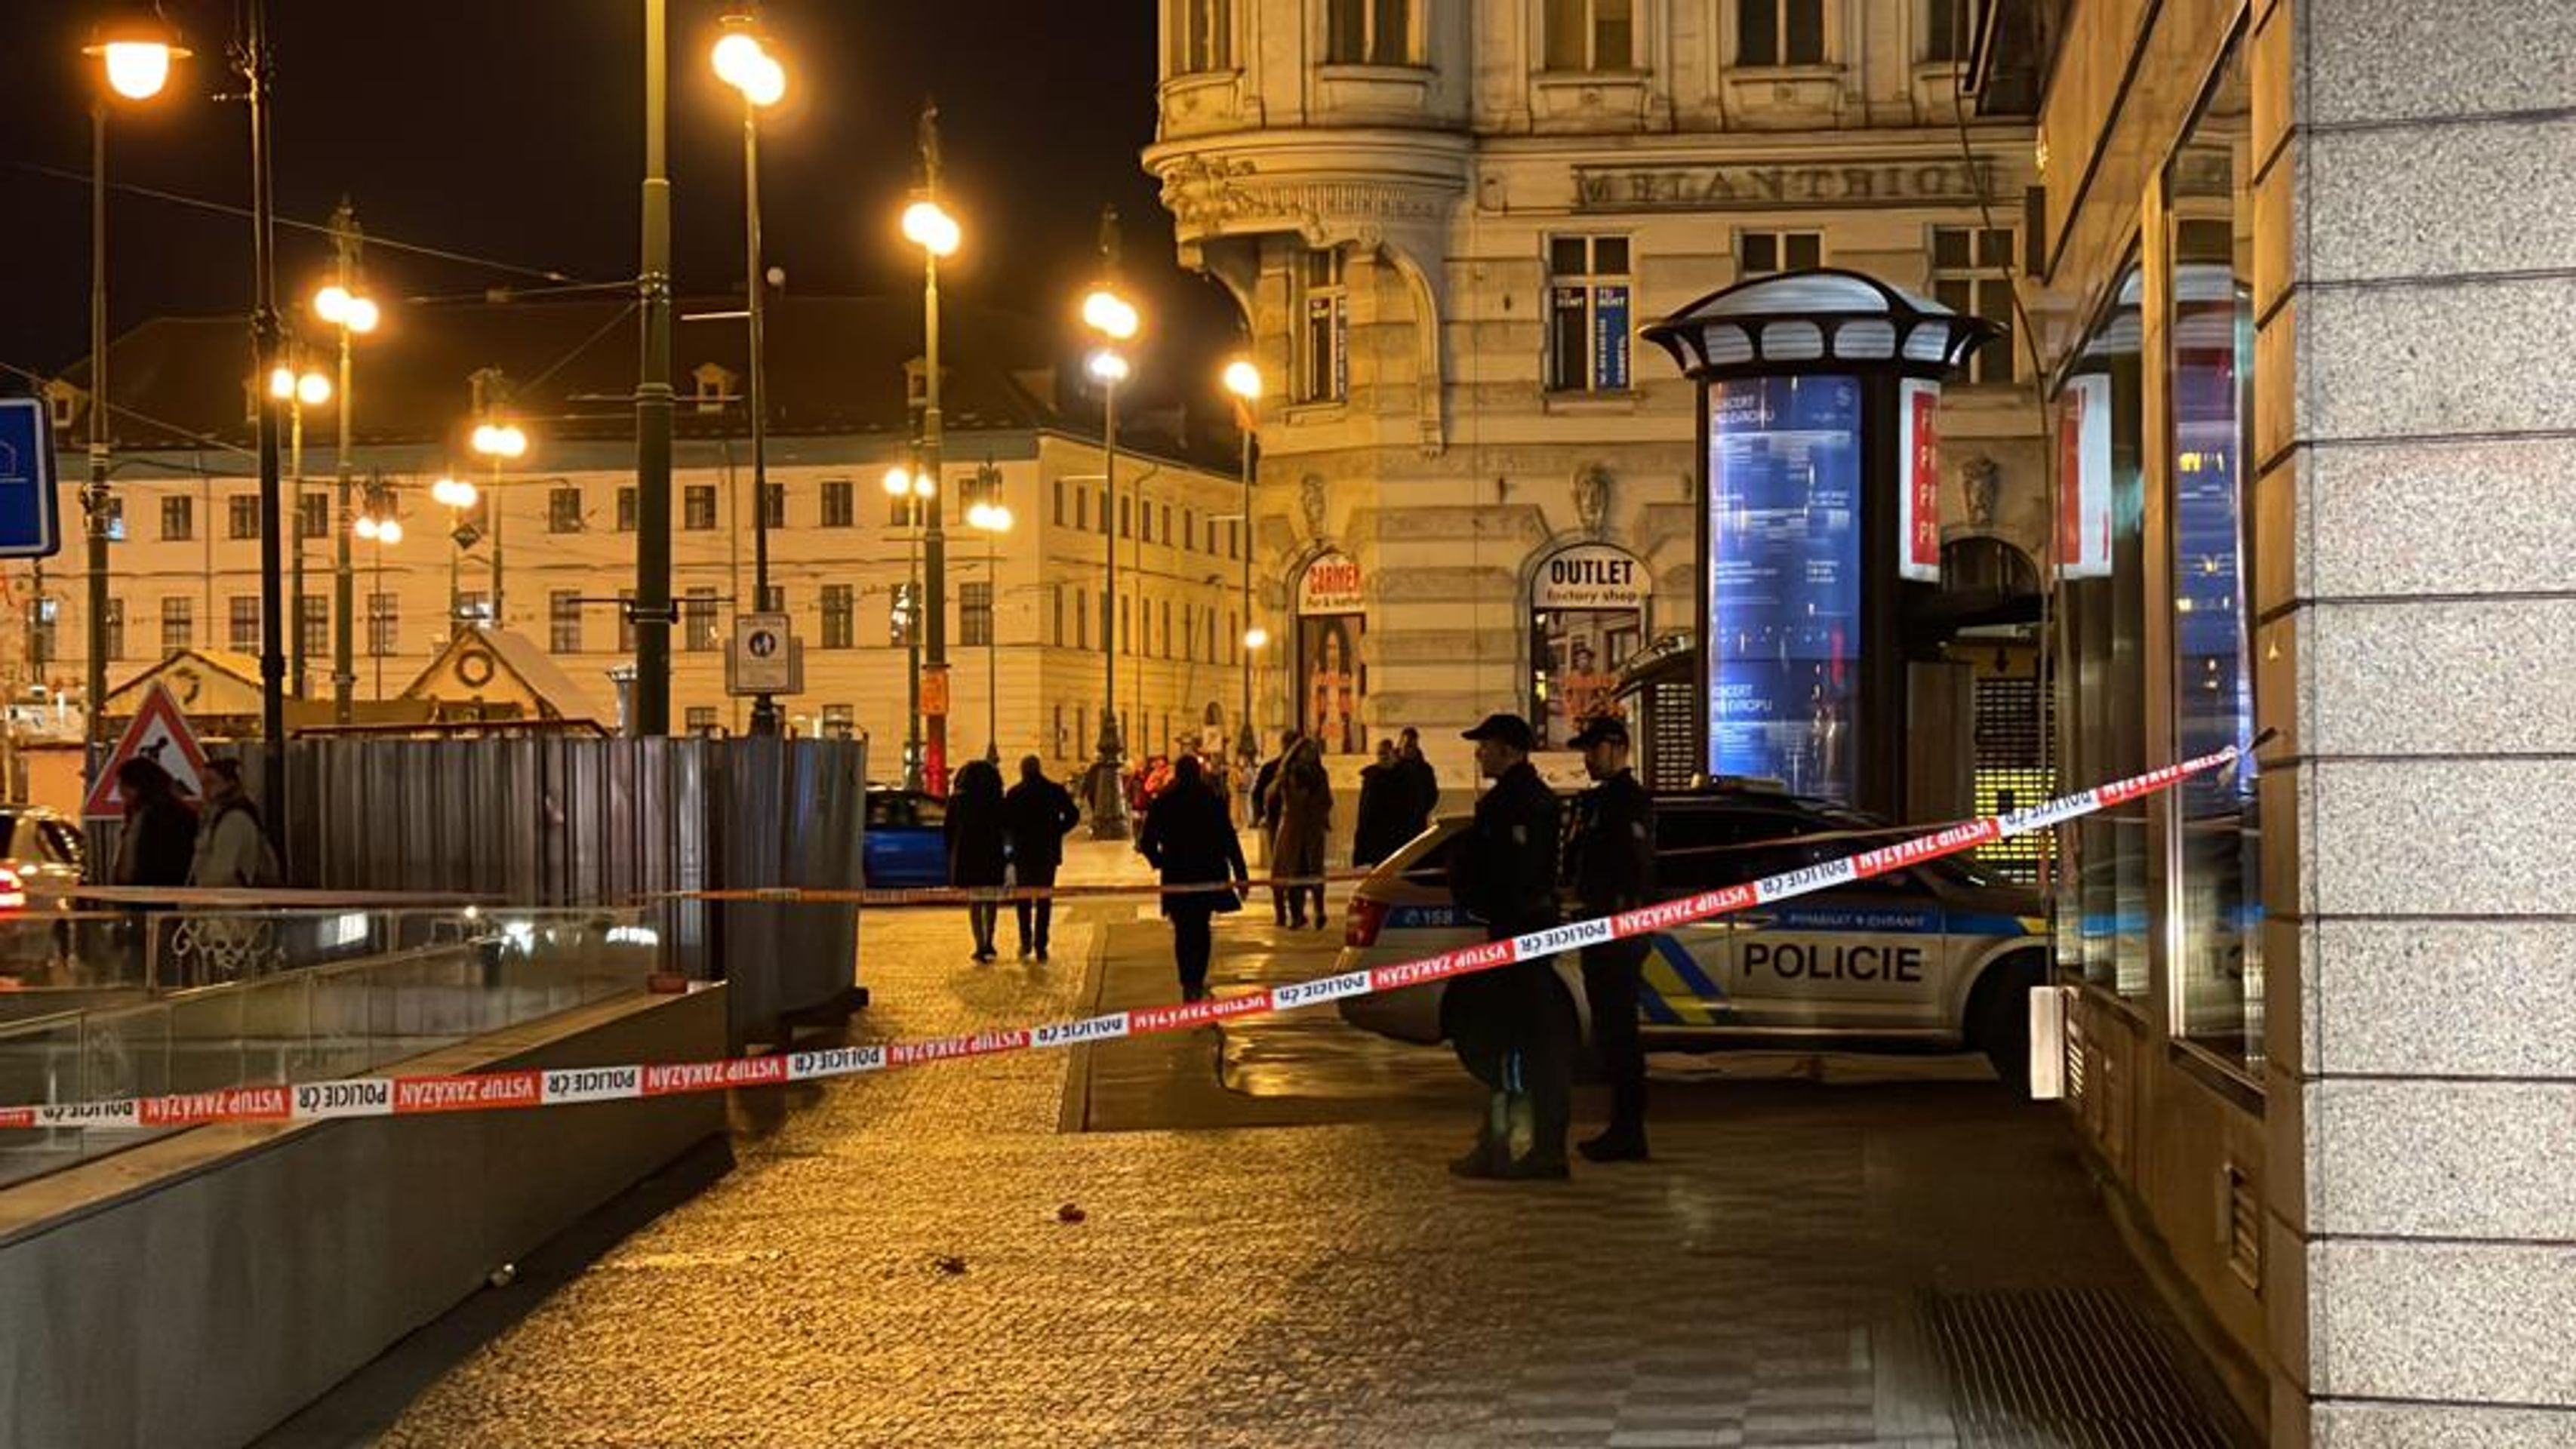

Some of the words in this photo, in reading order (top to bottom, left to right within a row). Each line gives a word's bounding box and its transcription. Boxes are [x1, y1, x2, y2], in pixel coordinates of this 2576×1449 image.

[1571, 165, 1993, 204] MELANTRICH
[1552, 560, 1633, 584] OUTLET
[1547, 589, 1598, 604] factory
[1602, 589, 1636, 603] shop
[1937, 820, 1992, 846] VSTUP
[1789, 860, 1848, 887] POLICIE
[1696, 888, 1750, 911] VSTUP
[1547, 921, 1607, 942] POLICIE
[1454, 945, 1508, 968] VSTUP
[1521, 937, 1541, 953] ČR
[1743, 943, 1922, 982] POLICIE
[1304, 975, 1365, 998] POLICIE
[1212, 995, 1266, 1014] VSTUP
[1062, 1017, 1124, 1038] POLICIE
[969, 1030, 1024, 1051] VSTUP
[726, 1057, 780, 1081] VSTUP
[819, 1047, 879, 1069] POLICIE
[481, 1075, 534, 1100] VSTUP
[548, 1075, 570, 1095] ČR
[574, 1069, 635, 1091] POLICIE
[229, 1089, 284, 1114] VSTUP
[299, 1086, 320, 1112] ČR
[324, 1082, 386, 1108] POLICIE
[399, 1081, 478, 1109] ZAKÁZÁN
